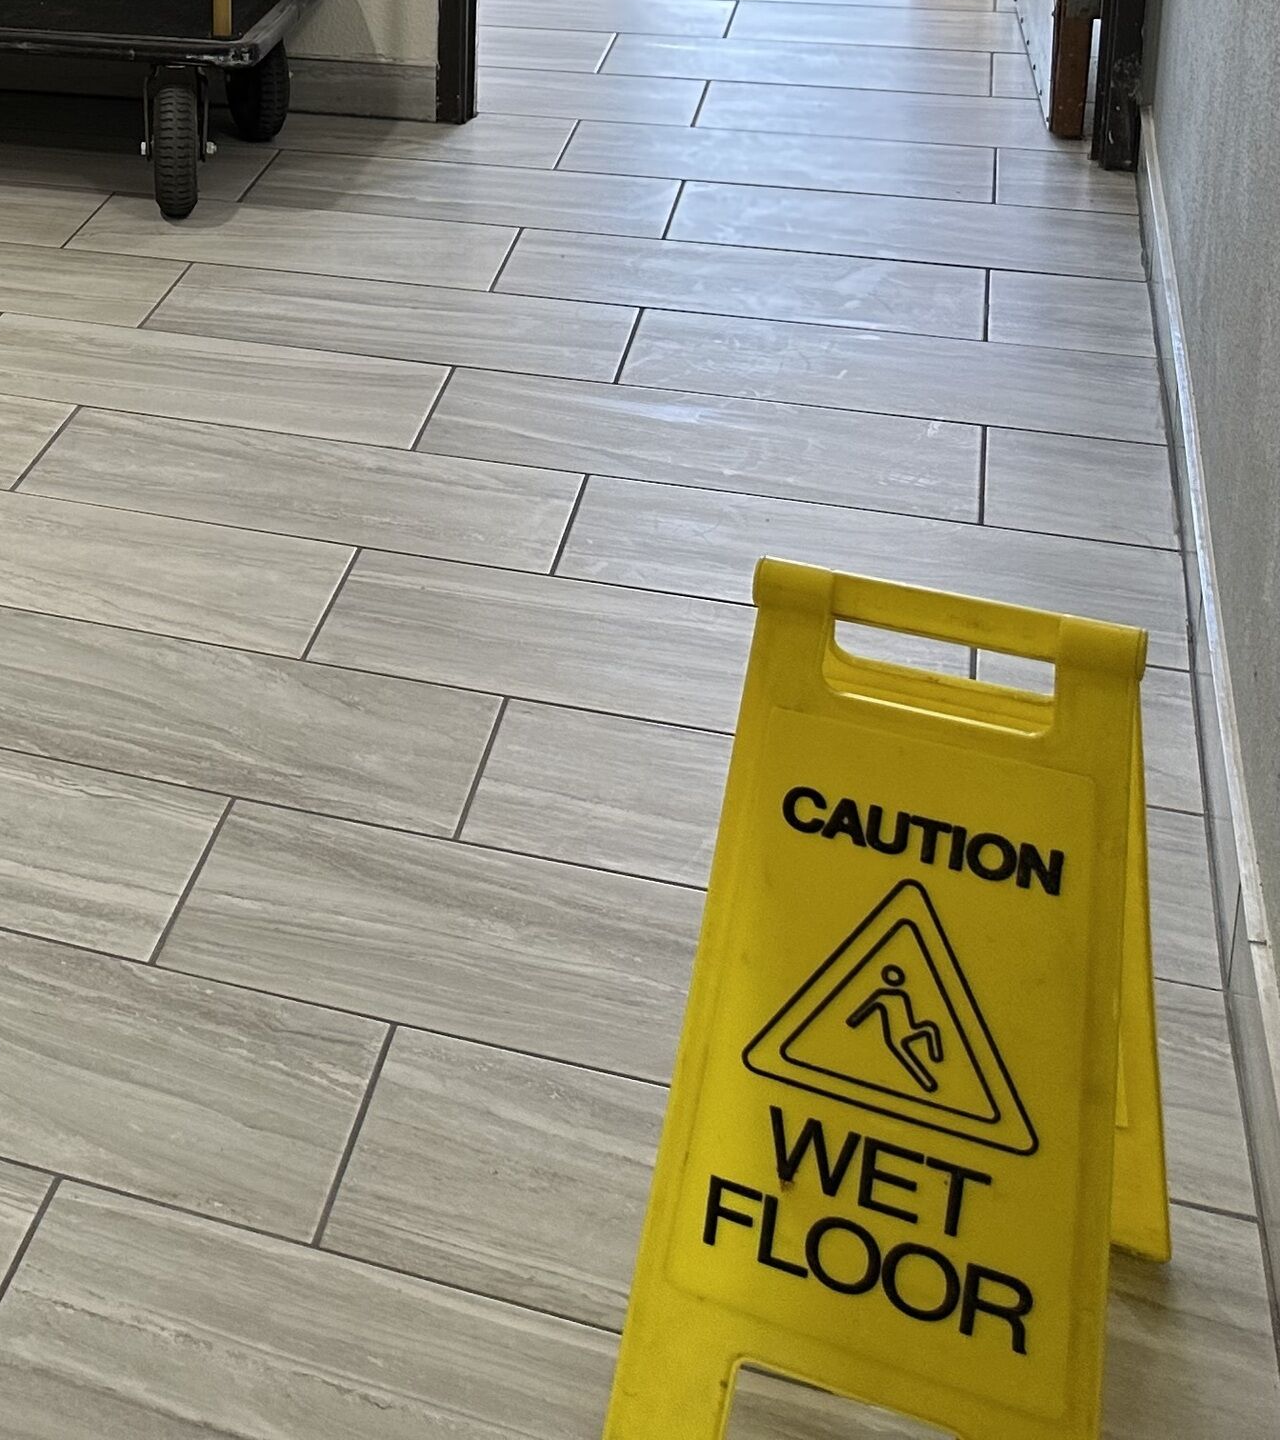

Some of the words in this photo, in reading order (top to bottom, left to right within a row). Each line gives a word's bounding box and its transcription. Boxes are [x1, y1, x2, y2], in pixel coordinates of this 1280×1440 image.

[781, 785, 1065, 897] CAUTION
[769, 1106, 991, 1237] WET
[702, 1175, 1036, 1355] FLOOR
